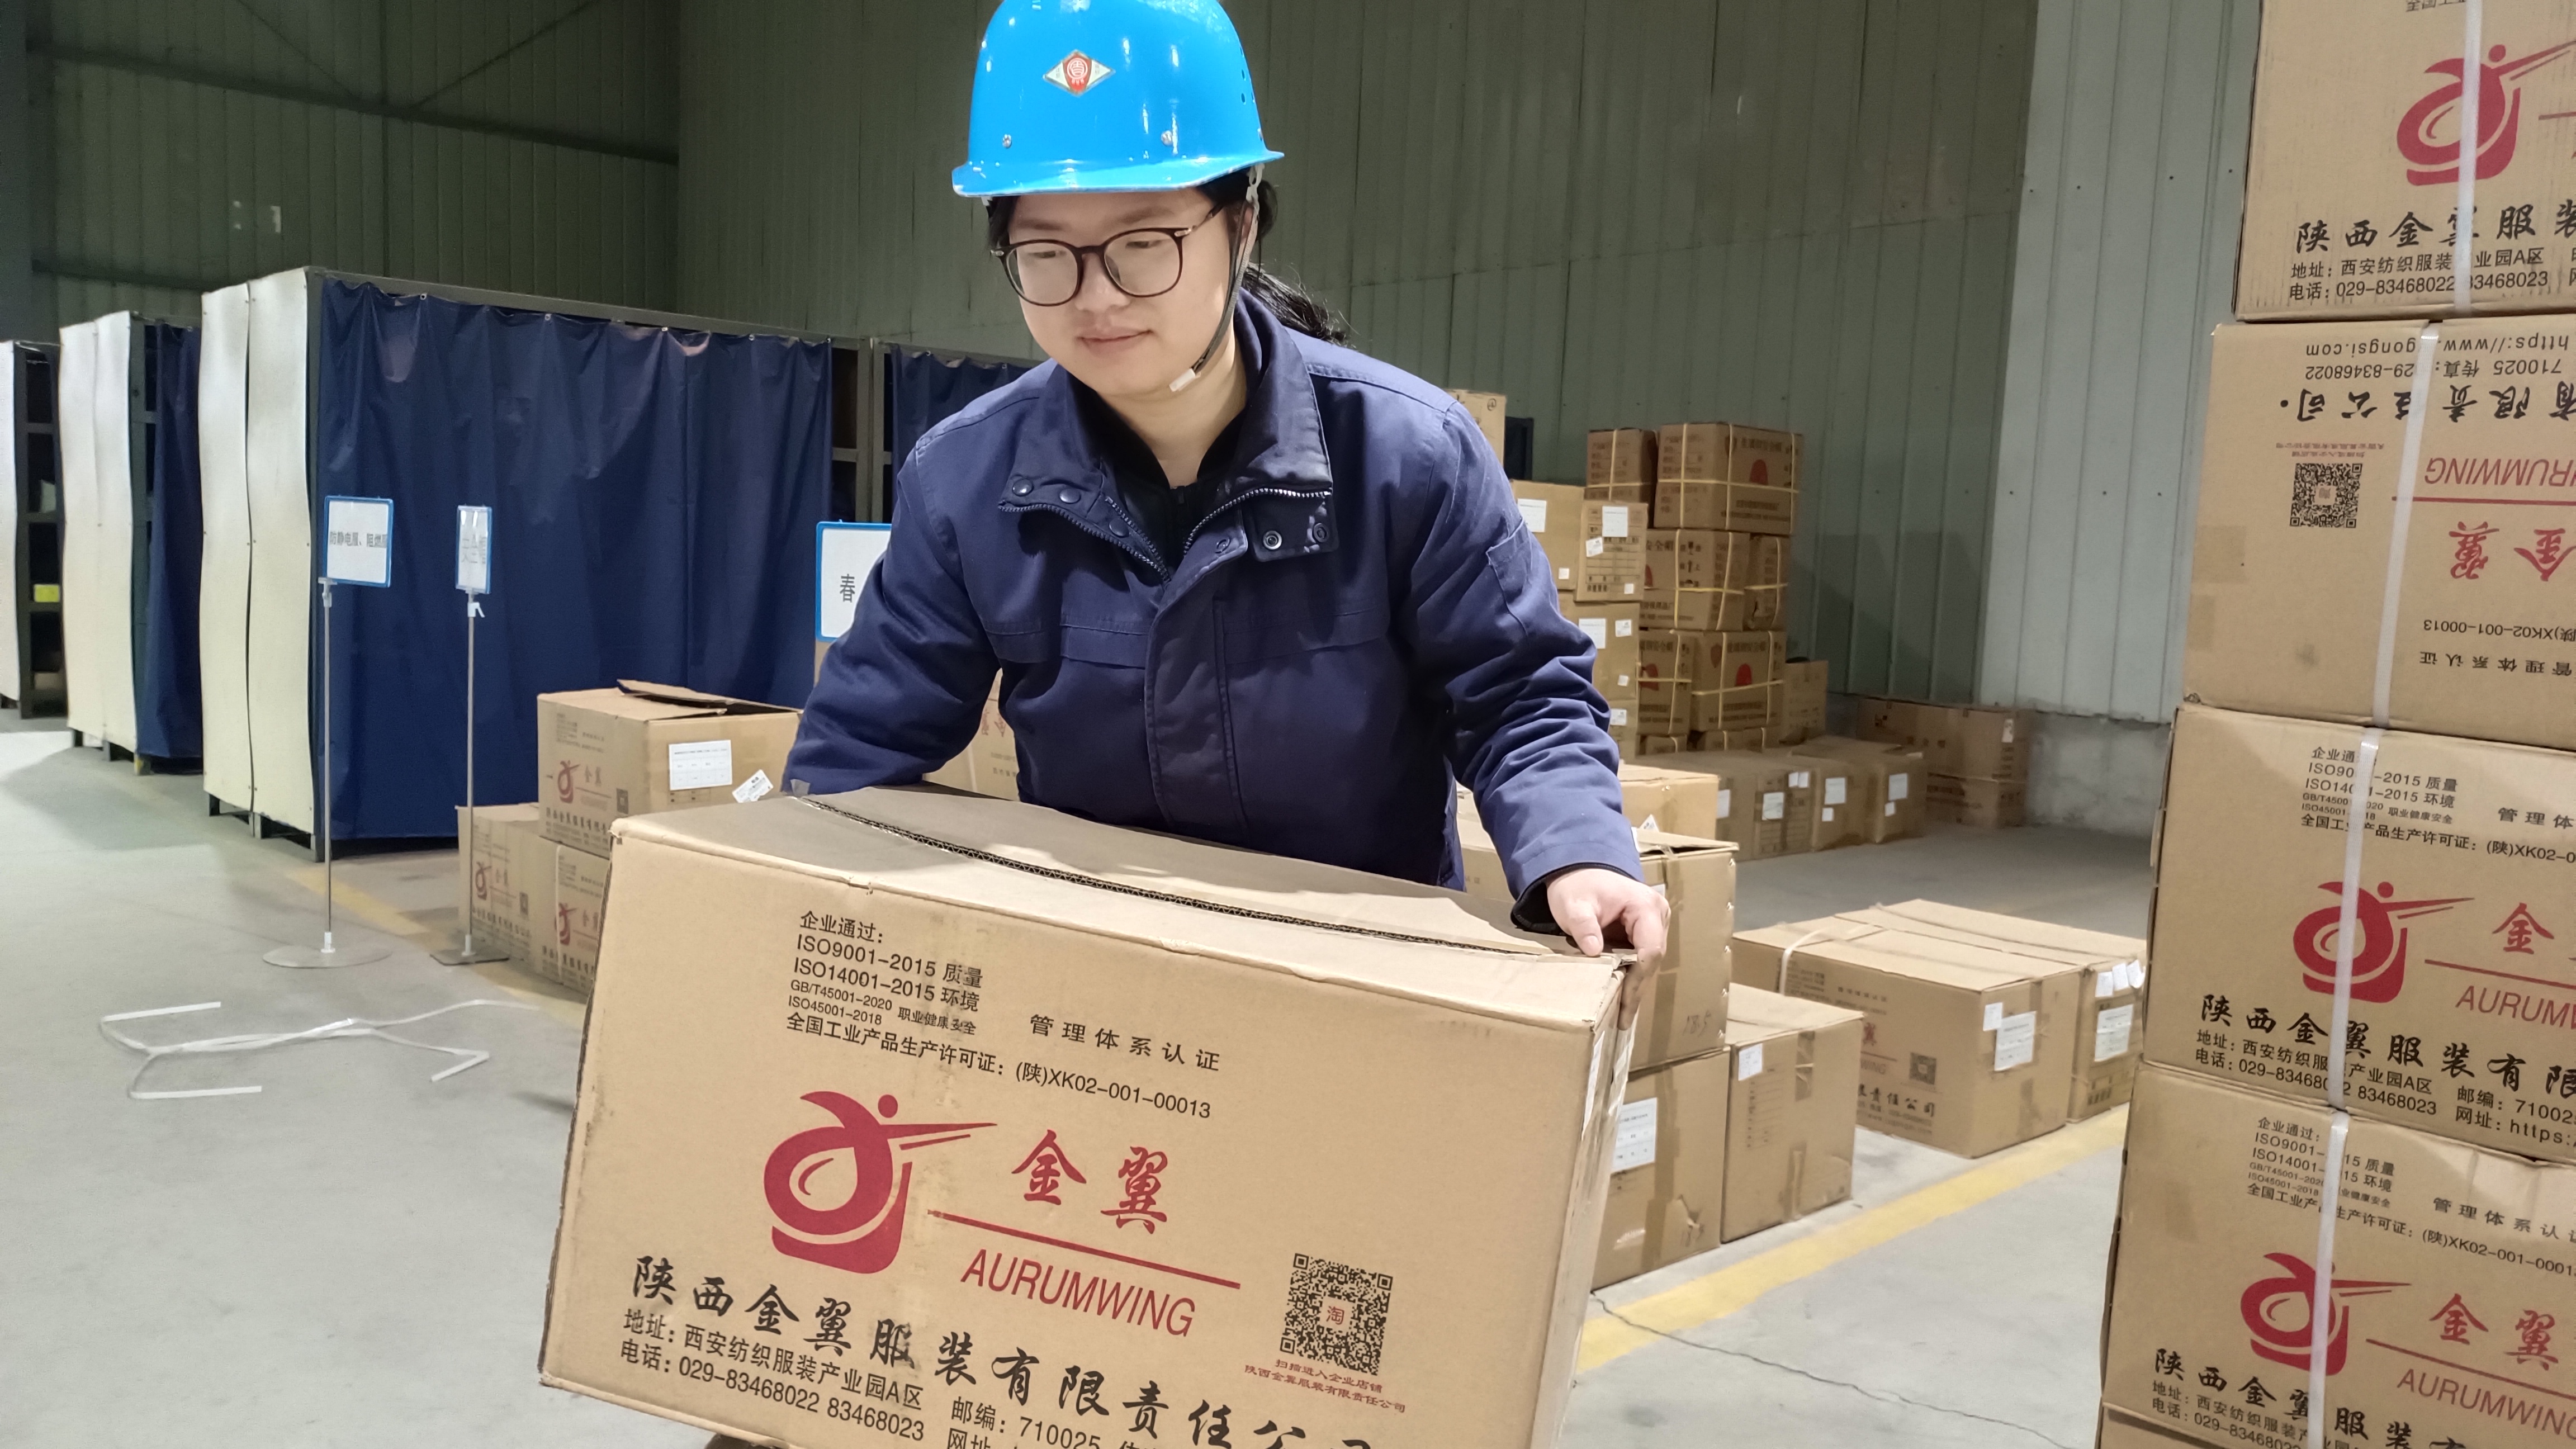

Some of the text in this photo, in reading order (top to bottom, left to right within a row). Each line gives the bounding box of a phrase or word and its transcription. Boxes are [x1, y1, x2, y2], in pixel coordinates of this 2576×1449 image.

[2291, 248, 2544, 279] 地址：西安纺织服装业园A区
[2469, 272, 2548, 291] 3468023
[2305, 359, 2561, 378] 710025 传真：29-83468022
[2425, 457, 2576, 487] RUMWING
[2448, 521, 2576, 582] 金翼
[2419, 651, 2572, 676] 管理体系认证
[2311, 747, 2376, 766] 企业通：
[2305, 778, 2455, 808] ISO141-2015 环境
[2309, 763, 2457, 792] ISO90-2015 质量
[2498, 807, 2576, 829] 管理体
[800, 911, 883, 944] 企业通过：
[2492, 902, 2576, 962] 金
[797, 934, 983, 988] ISO9001-2015 质量
[790, 979, 892, 1011] GB/T45001-2020
[794, 957, 979, 1012] ISO14001-2015 环境
[788, 995, 882, 1025] ISO45001-2018
[898, 1007, 976, 1035] 职业健康安全
[1030, 1014, 1220, 1072] 管理体系认证
[2196, 1029, 2432, 1094] 地址：西安纺织服产业园A区
[2196, 1048, 2436, 1115] 电话：029-834682 83468023
[2457, 1086, 2576, 1125] 邮编：71002
[2252, 1147, 2358, 1182] ISO14001-15
[2255, 1132, 2360, 1167] ISO9001-15
[1011, 1129, 1168, 1234] 金翼
[2338, 1186, 2391, 1209] 业健康安全
[960, 1249, 1196, 1338] AURUMWING
[1327, 1306, 1345, 1325] 淘
[2429, 1294, 2559, 1371] 金翼
[633, 1256, 1371, 1449] 陕西金翼服装有限责任公
[827, 1398, 925, 1442] 83468023
